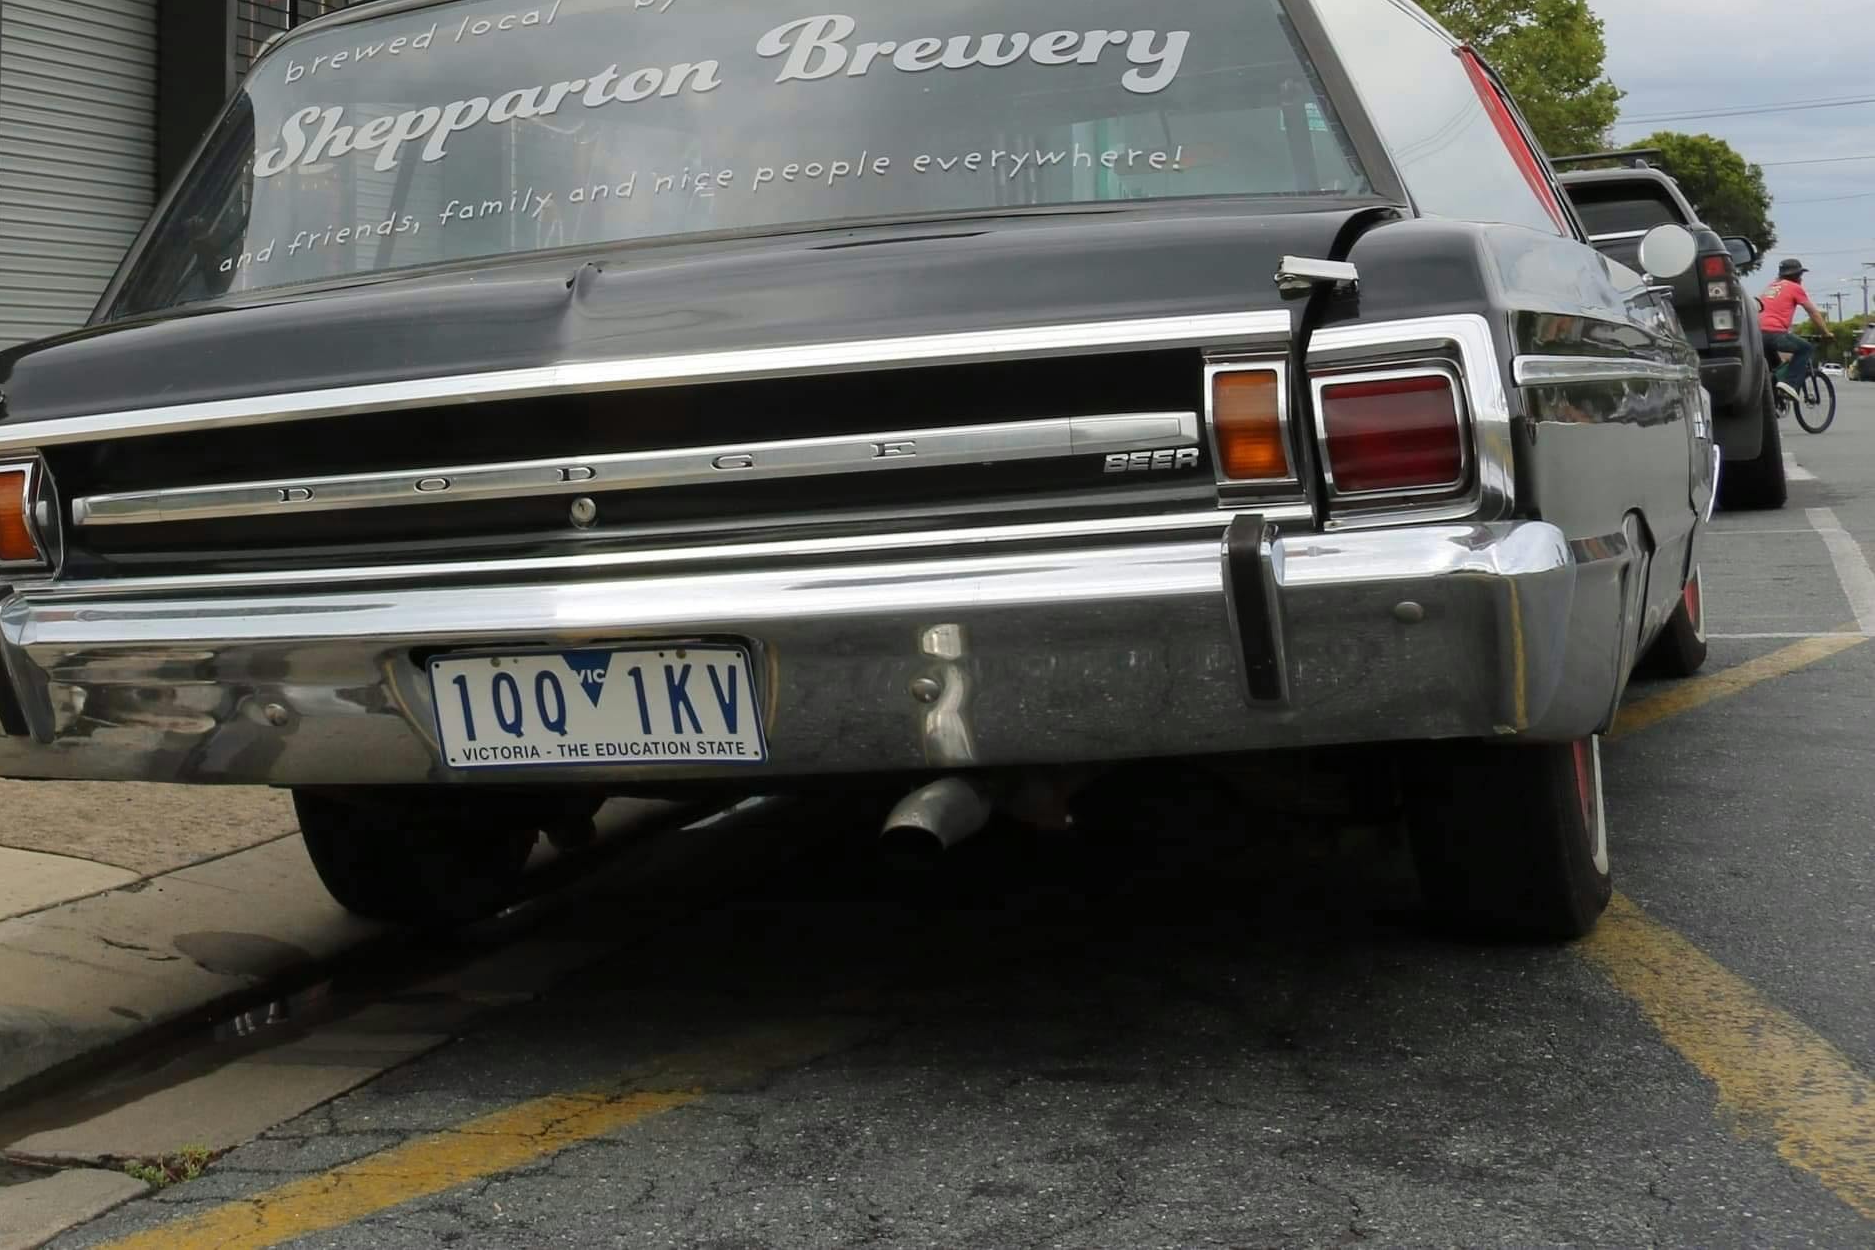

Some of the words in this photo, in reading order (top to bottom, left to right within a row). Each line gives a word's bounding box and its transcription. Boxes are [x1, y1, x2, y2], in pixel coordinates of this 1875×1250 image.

[284, 23, 438, 85] brewed
[253, 59, 722, 178] Shepparton
[756, 13, 1191, 94] Brewery
[219, 238, 276, 273] and
[288, 211, 421, 256] friends,
[438, 186, 553, 225] family
[569, 172, 637, 203] and
[654, 166, 734, 193] nice
[752, 150, 892, 192] people
[913, 144, 1184, 178] everywhere!
[277, 440, 918, 503] DODGE
[1103, 447, 1200, 473] BEER
[452, 669, 569, 742] 1QQ
[627, 663, 738, 735] 1KV
[574, 668, 606, 684] VIC
[462, 746, 540, 762] VICTORIA
[556, 743, 590, 758] THE
[595, 741, 691, 757] EDUCATION
[696, 740, 746, 756] STATE
